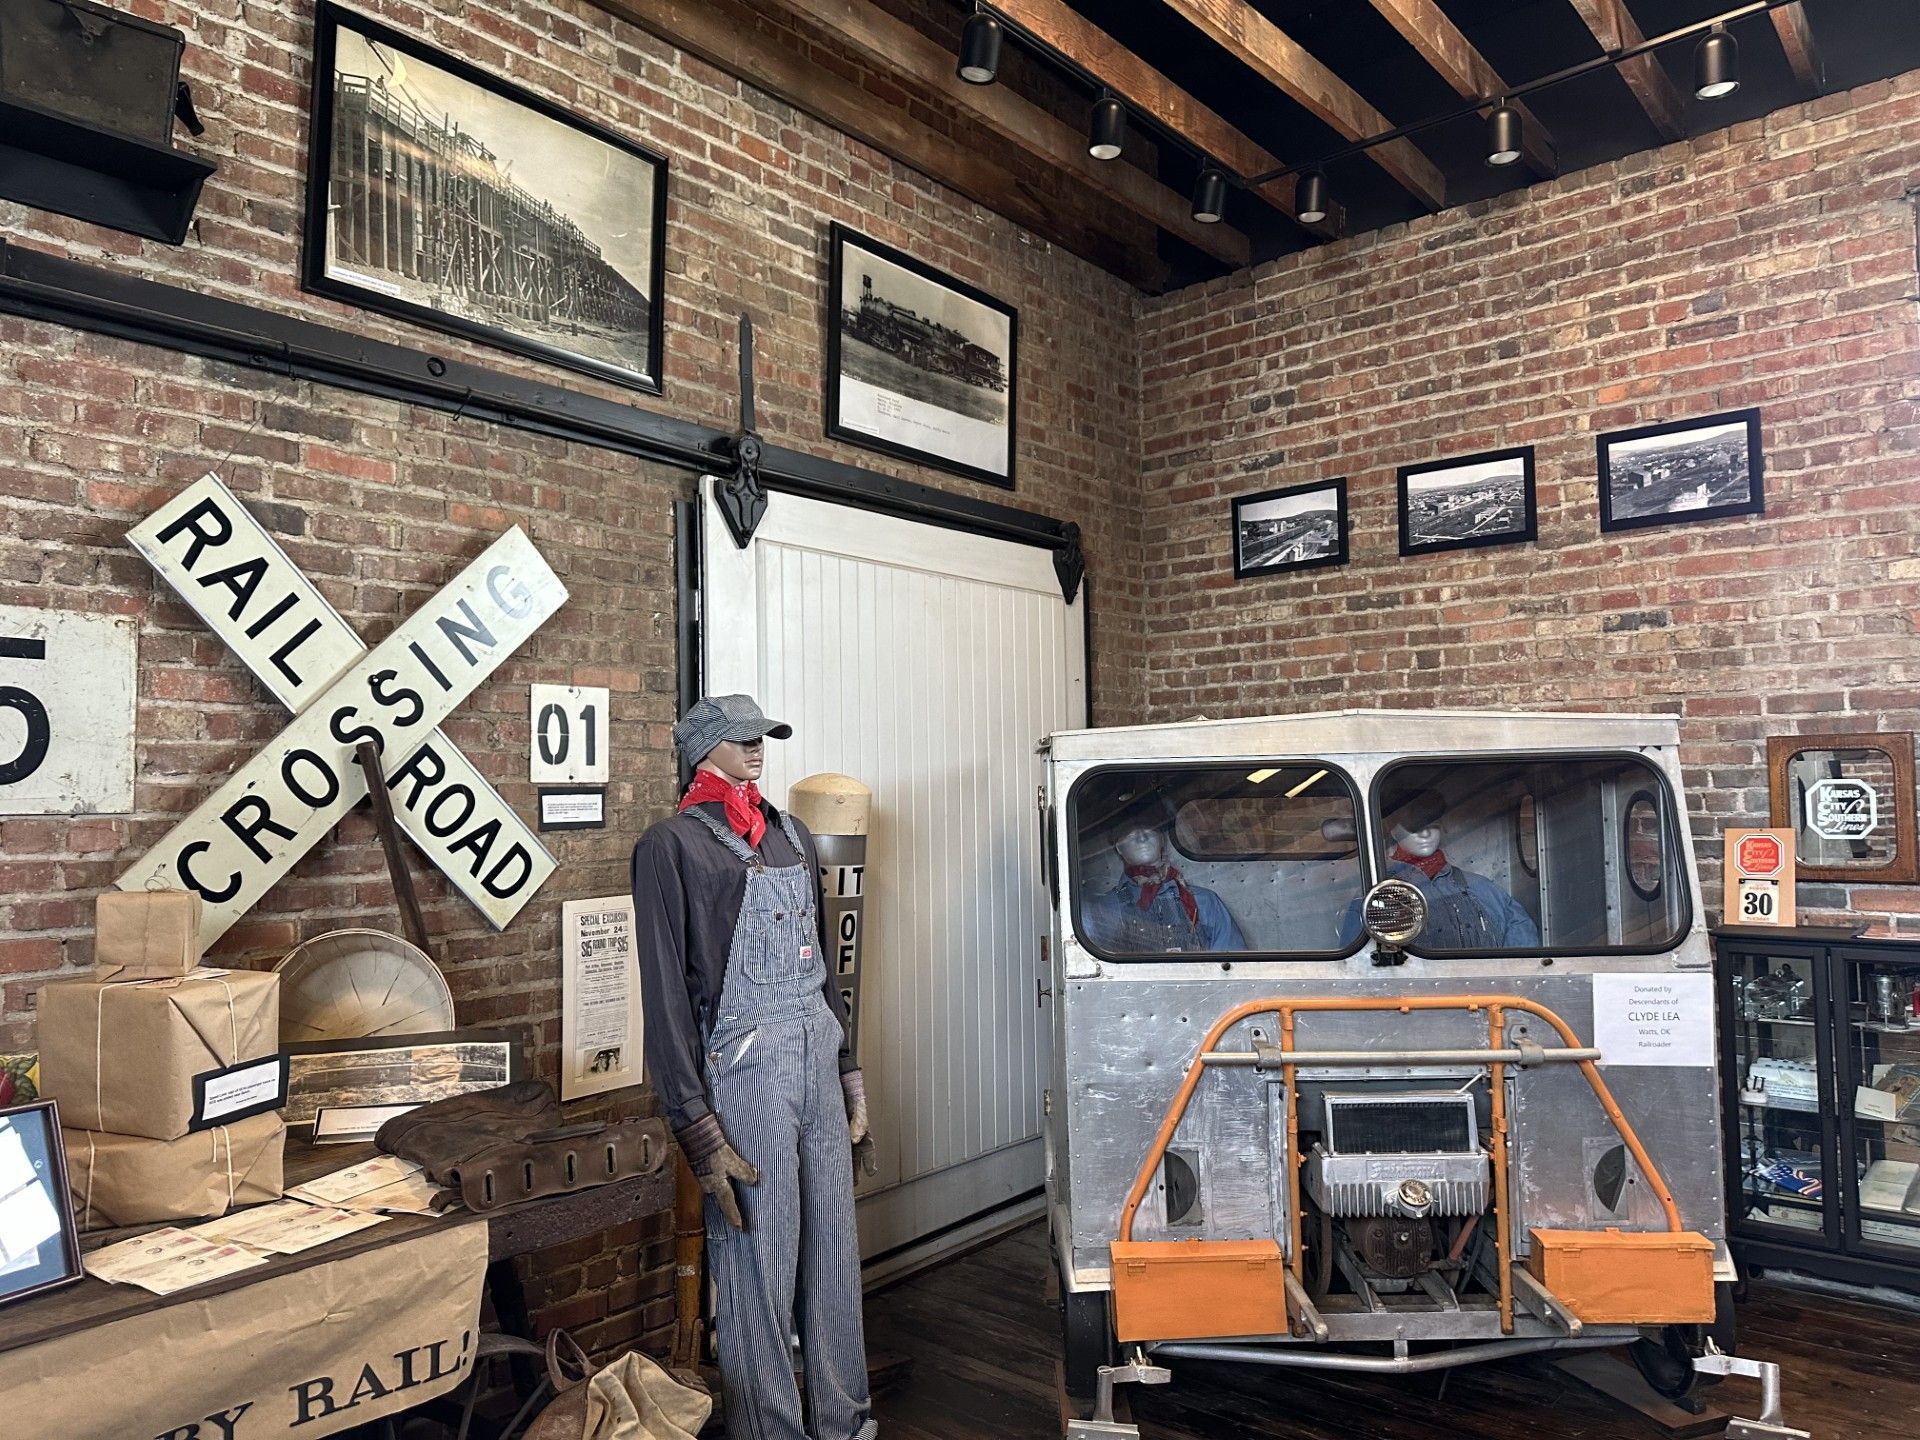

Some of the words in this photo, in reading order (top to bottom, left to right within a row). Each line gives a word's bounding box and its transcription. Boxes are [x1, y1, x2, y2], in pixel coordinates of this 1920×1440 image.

[156, 497, 322, 687] RAIL
[177, 565, 534, 904] CROSSING
[537, 703, 596, 766] 01
[387, 744, 533, 899] ROAD
[1744, 892, 1773, 916] 30
[1629, 998, 1670, 1006] Descendants
[1671, 997, 1680, 1005] of
[1634, 985, 1663, 993] Donated
[1663, 985, 1672, 994] by
[1628, 1011, 1660, 1021] CLYDE
[1662, 1011, 1681, 1021] LEA
[1660, 1028, 1671, 1036] OK
[289, 1330, 470, 1428] RAIL!
